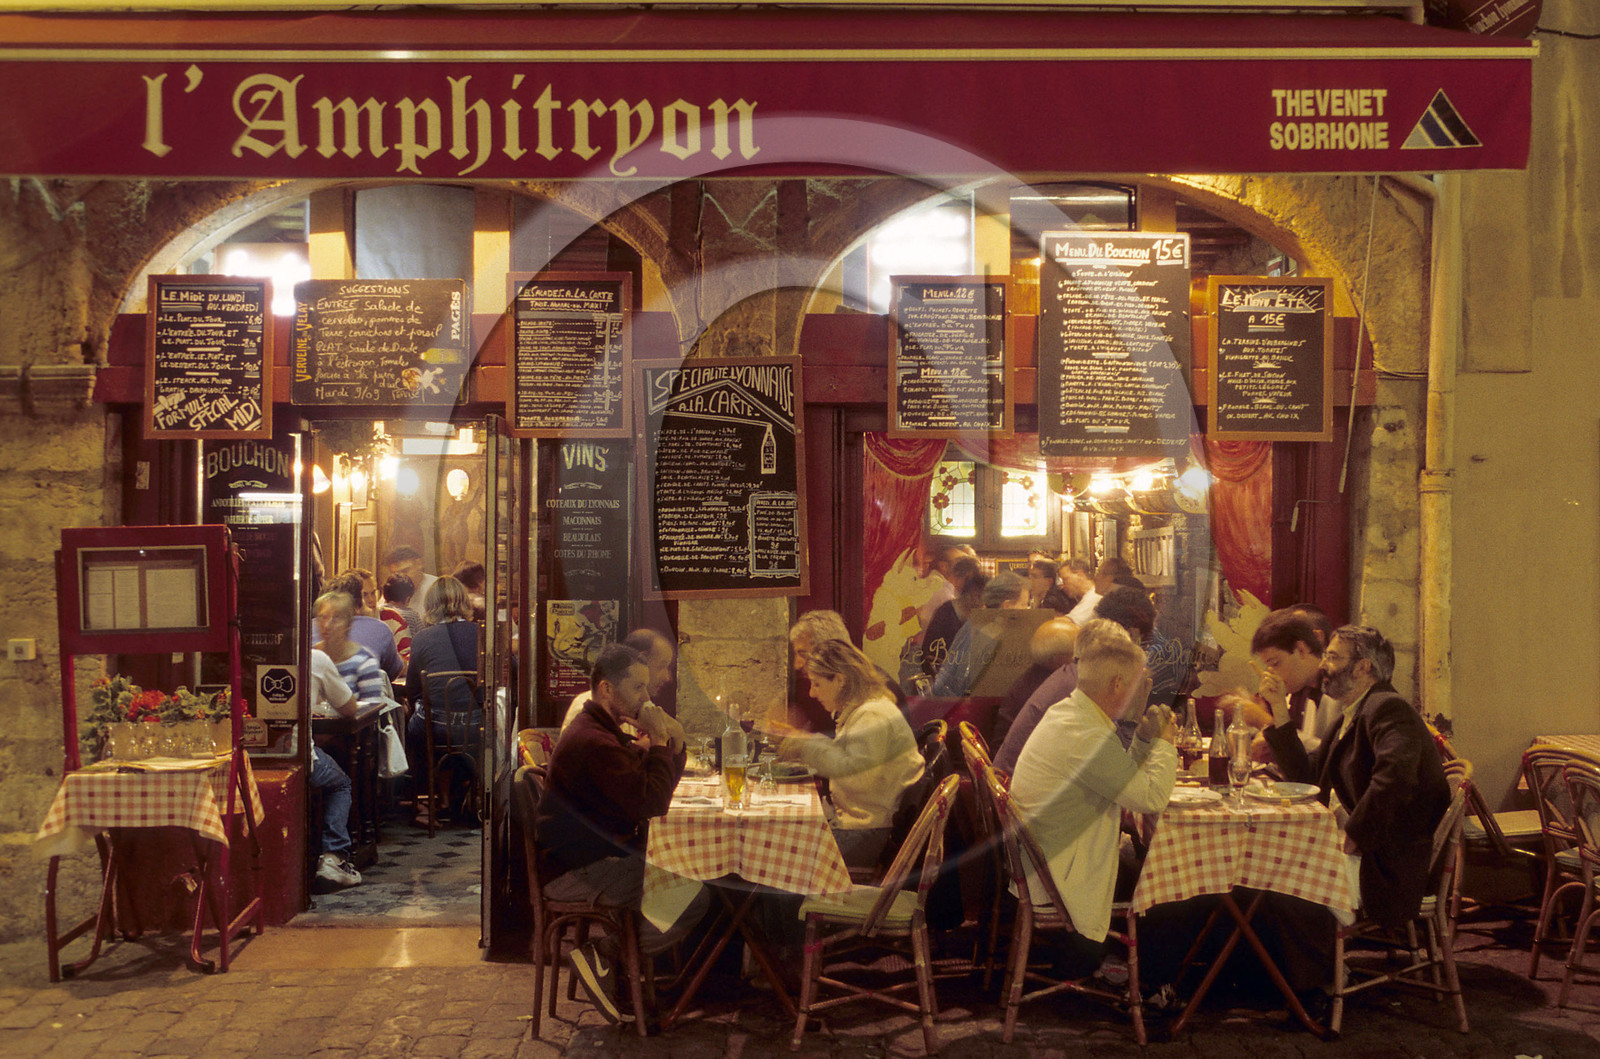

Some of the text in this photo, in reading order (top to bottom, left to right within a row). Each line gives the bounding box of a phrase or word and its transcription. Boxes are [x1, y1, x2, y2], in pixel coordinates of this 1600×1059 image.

[1271, 89, 1388, 117] THEVENET
[1269, 122, 1390, 150] SOBRHONE
[1105, 242, 1150, 258] BOUCHON
[1152, 239, 1183, 260] 15€
[339, 281, 411, 294] SUGGESTIONS
[405, 300, 423, 314] de
[1260, 312, 1287, 326] 15€
[295, 337, 312, 382] VERVEINE
[155, 393, 210, 429] FORMULE
[189, 394, 239, 431] SPECIAL
[207, 440, 289, 478] BOUCHON
[562, 442, 609, 472] VINS
